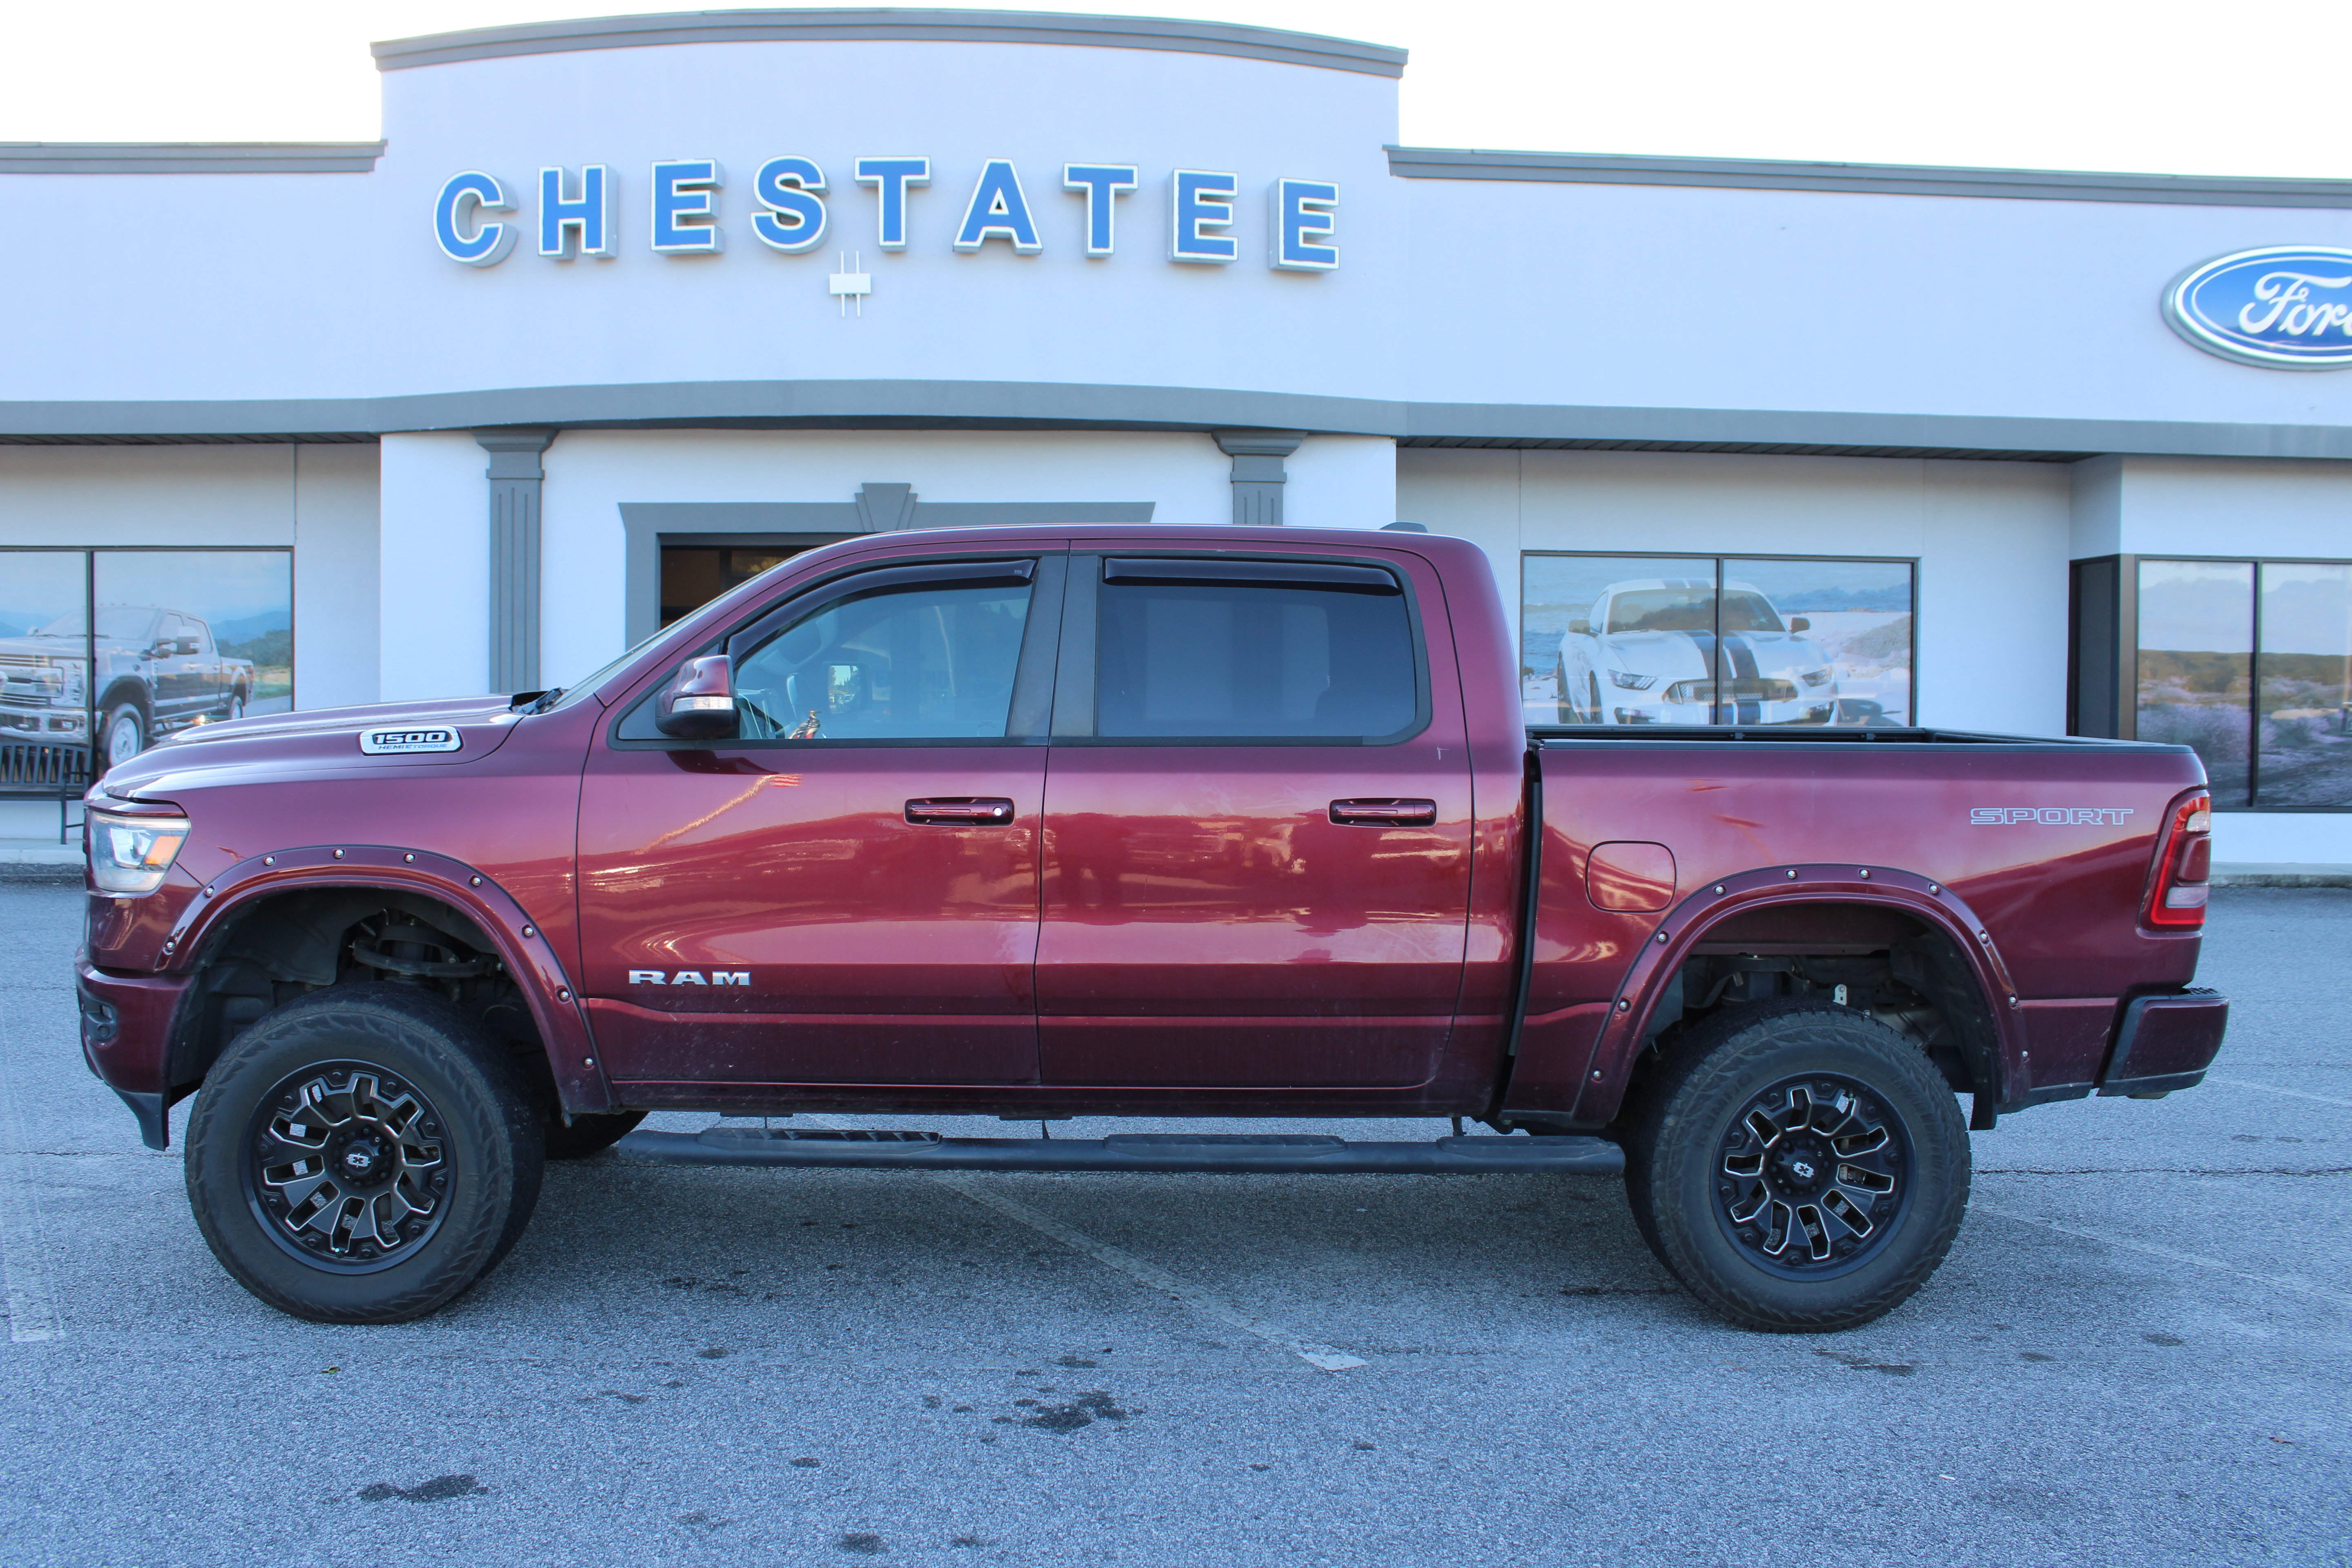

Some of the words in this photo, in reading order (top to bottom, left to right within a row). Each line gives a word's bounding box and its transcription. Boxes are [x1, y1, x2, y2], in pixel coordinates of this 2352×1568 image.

[432, 154, 1341, 272] CHESTATEE
[2238, 271, 2352, 337] For
[376, 732, 446, 744] 1500
[1970, 807, 2134, 825] SPORT
[628, 969, 751, 986] RAM
